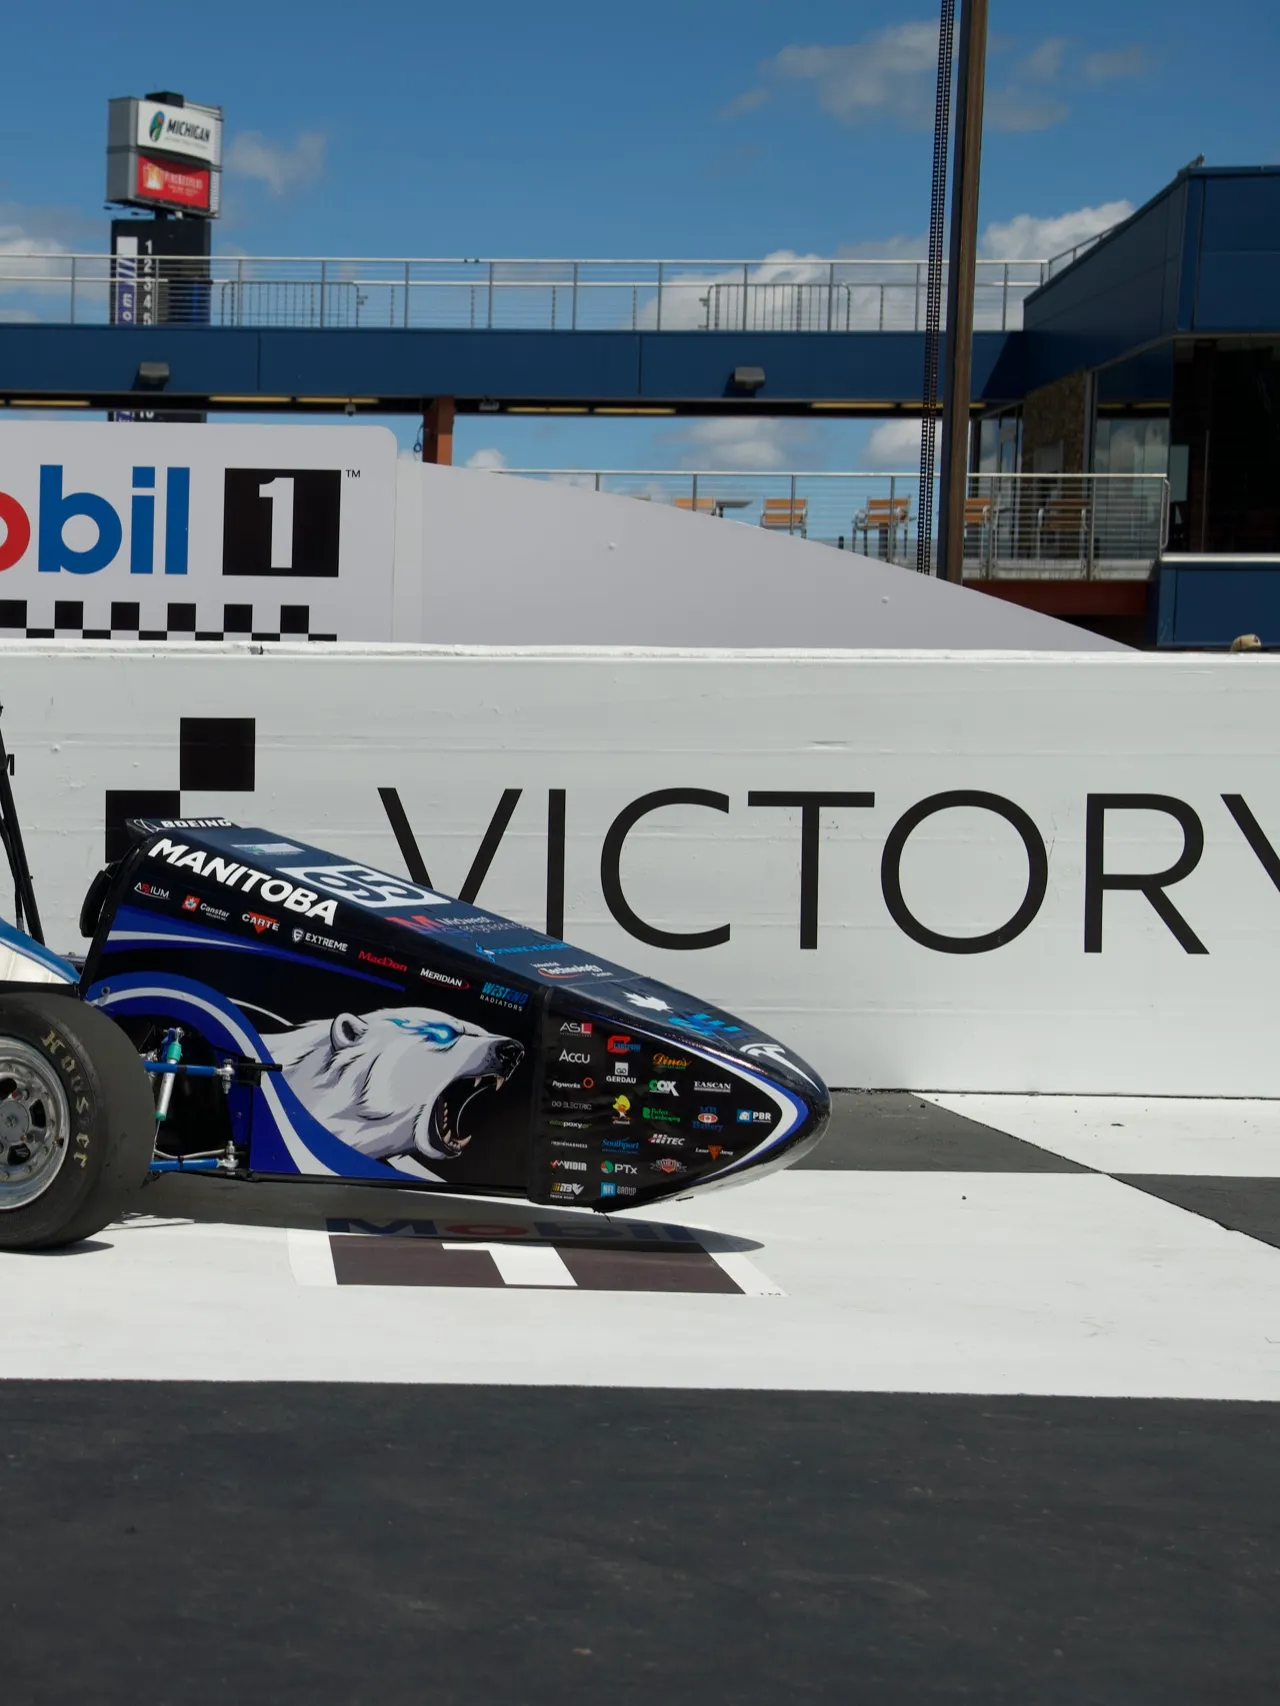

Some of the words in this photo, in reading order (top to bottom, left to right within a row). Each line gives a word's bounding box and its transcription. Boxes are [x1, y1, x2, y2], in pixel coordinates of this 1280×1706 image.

[166, 118, 211, 143] MICHIGAN
[258, 477, 294, 569] 1
[161, 820, 232, 828] BOEING
[148, 838, 338, 926] MANITOBA
[200, 903, 230, 918] Canstar
[241, 912, 280, 932] CARTE
[305, 932, 348, 952] EXTREME
[358, 949, 408, 972] MacDon
[420, 967, 463, 987] MERIDIAN
[480, 994, 523, 1012] RADIATORS
[560, 1022, 592, 1034] ASL
[559, 1049, 591, 1064] ACCU
[606, 1075, 637, 1084] GERDAU
[648, 1079, 680, 1096] COX
[694, 1081, 732, 1090] EASCAN
[752, 1111, 772, 1121] PBR
[564, 1161, 588, 1172] VIDIR
[617, 1186, 637, 1196] GROUP
[326, 1217, 696, 1243] Mobil
